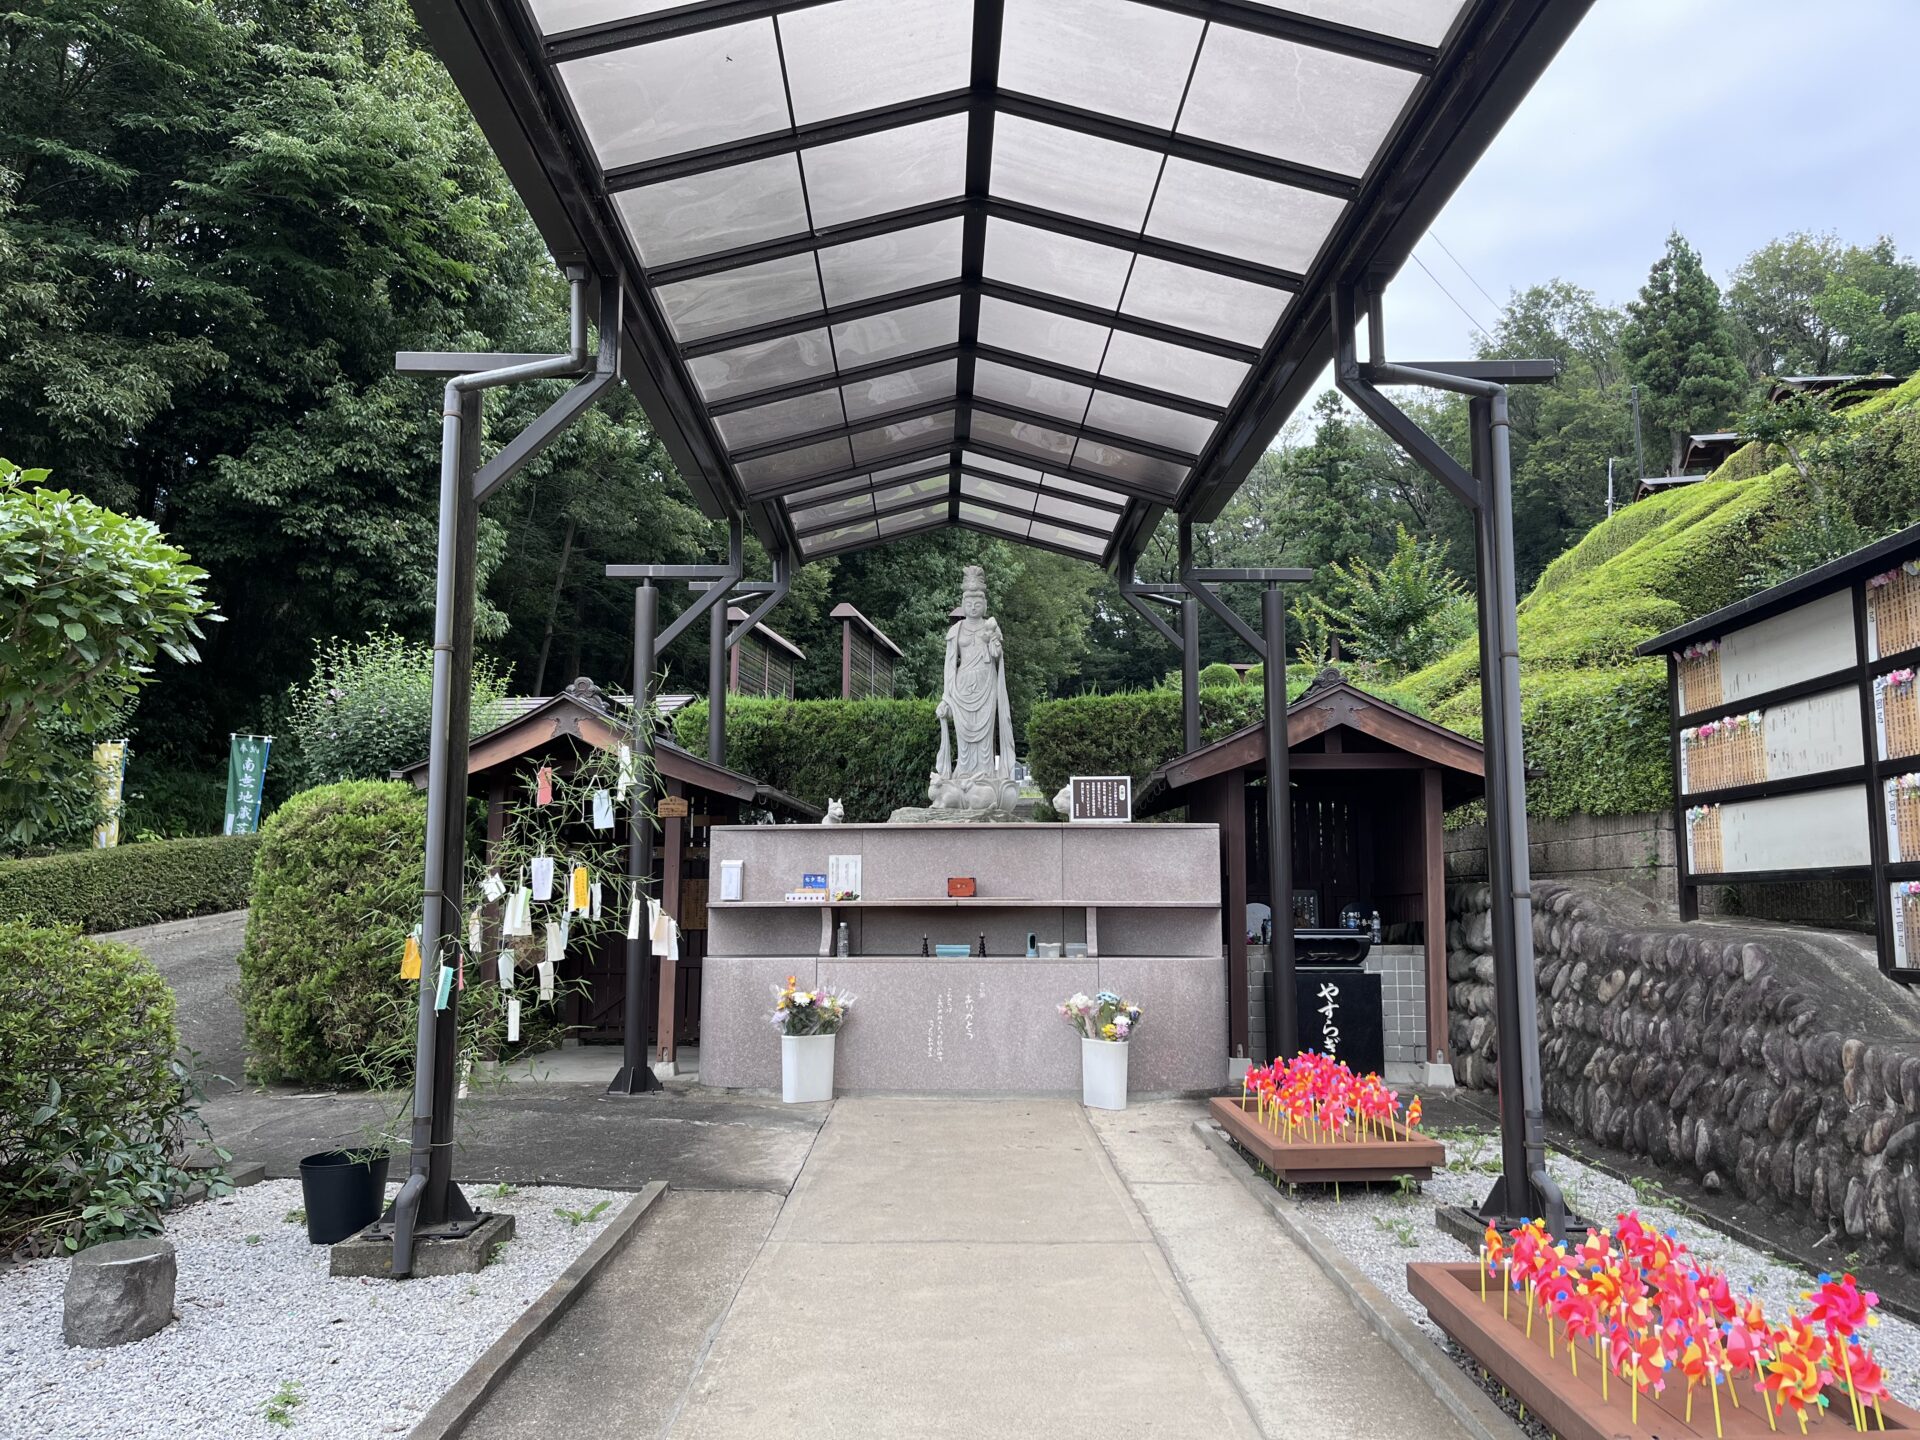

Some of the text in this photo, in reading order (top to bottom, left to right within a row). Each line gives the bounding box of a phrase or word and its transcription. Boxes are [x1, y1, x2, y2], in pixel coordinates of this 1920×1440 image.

[964, 993, 975, 1040] ありがとう
[1316, 982, 1342, 1053] やすらぎ
